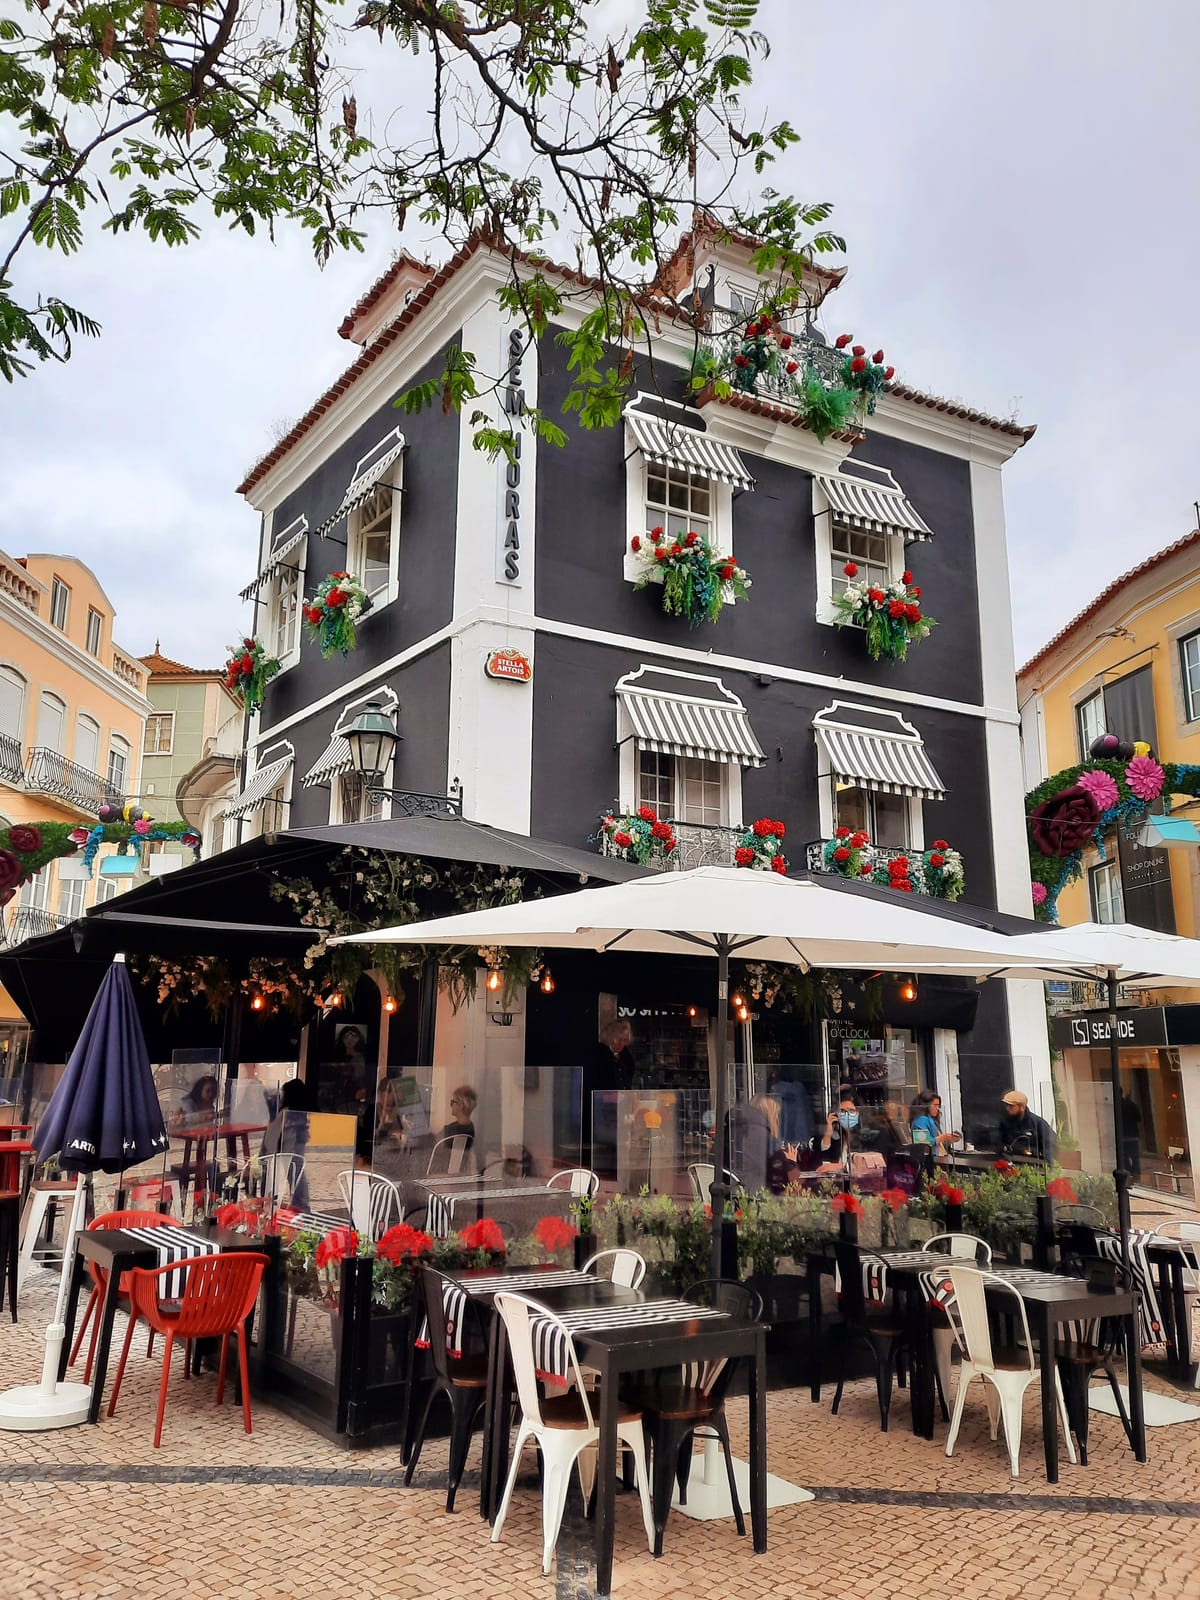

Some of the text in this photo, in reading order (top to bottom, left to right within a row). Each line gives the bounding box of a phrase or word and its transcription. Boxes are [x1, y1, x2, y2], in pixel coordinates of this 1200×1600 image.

[506, 329, 525, 417] SEM
[496, 665, 525, 675] ARTOIS
[497, 658, 524, 669] STELLA
[1127, 856, 1165, 873] SHOP ONLINE
[830, 1028, 870, 1039] O'CLOCK
[1092, 1020, 1135, 1040] SEAIDE
[70, 1139, 96, 1154] ARTO
